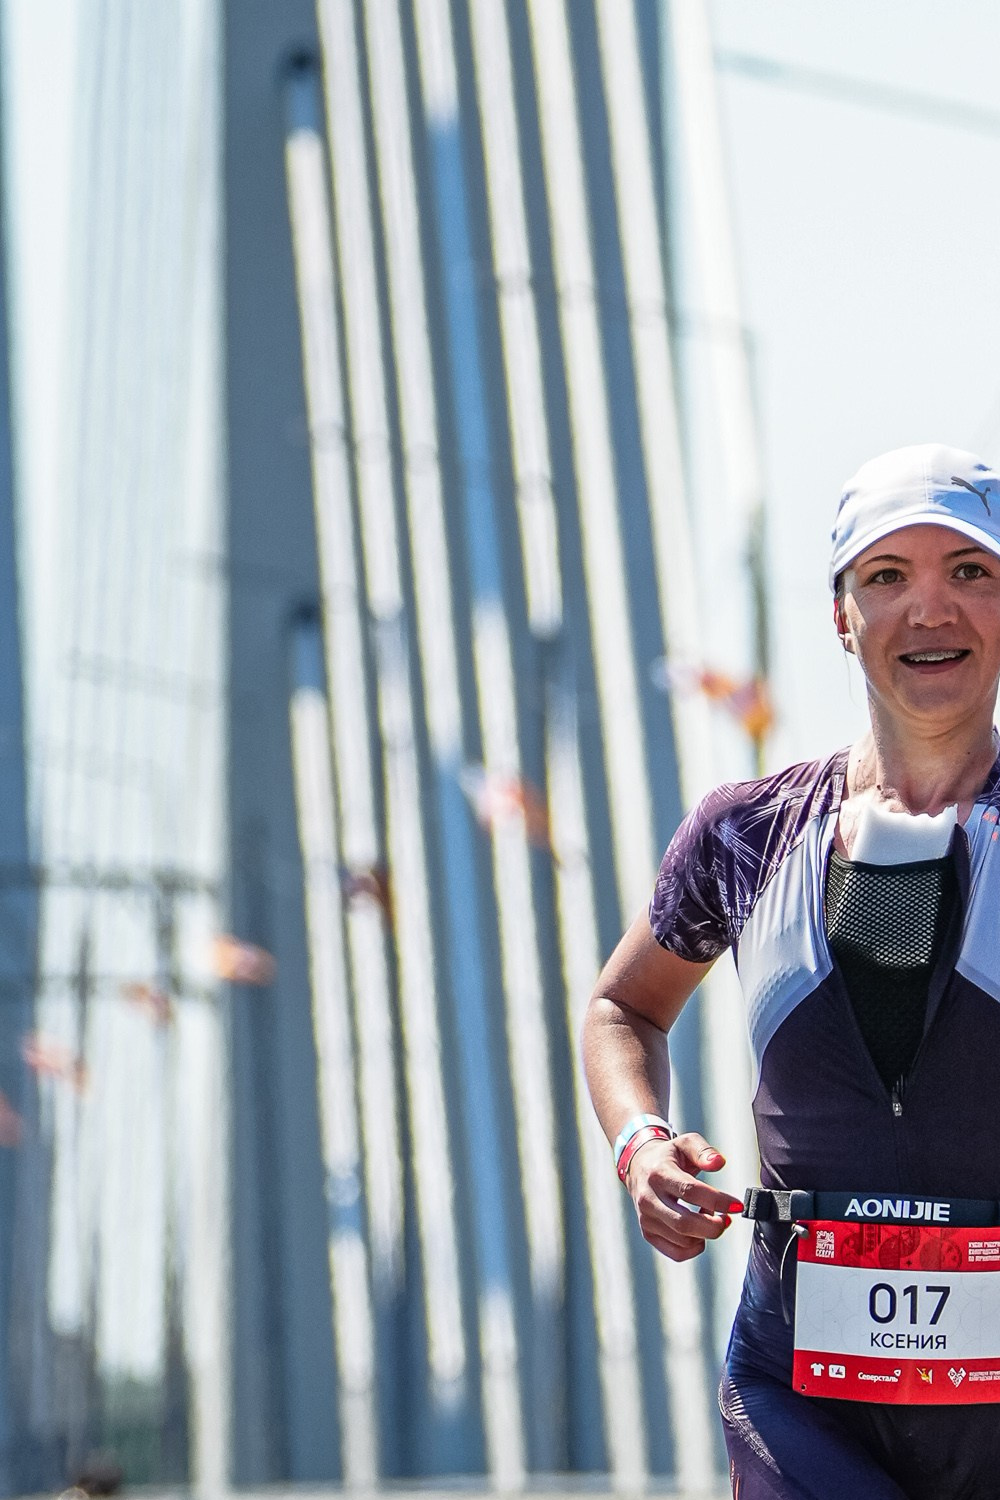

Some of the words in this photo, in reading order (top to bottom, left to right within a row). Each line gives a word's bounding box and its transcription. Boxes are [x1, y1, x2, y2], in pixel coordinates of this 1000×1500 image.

[844, 1199, 950, 1222] AONIJIE
[869, 1283, 951, 1325] 017
[870, 1332, 947, 1349] КСЕНИЯ
[858, 1372, 899, 1382] Северсталь
